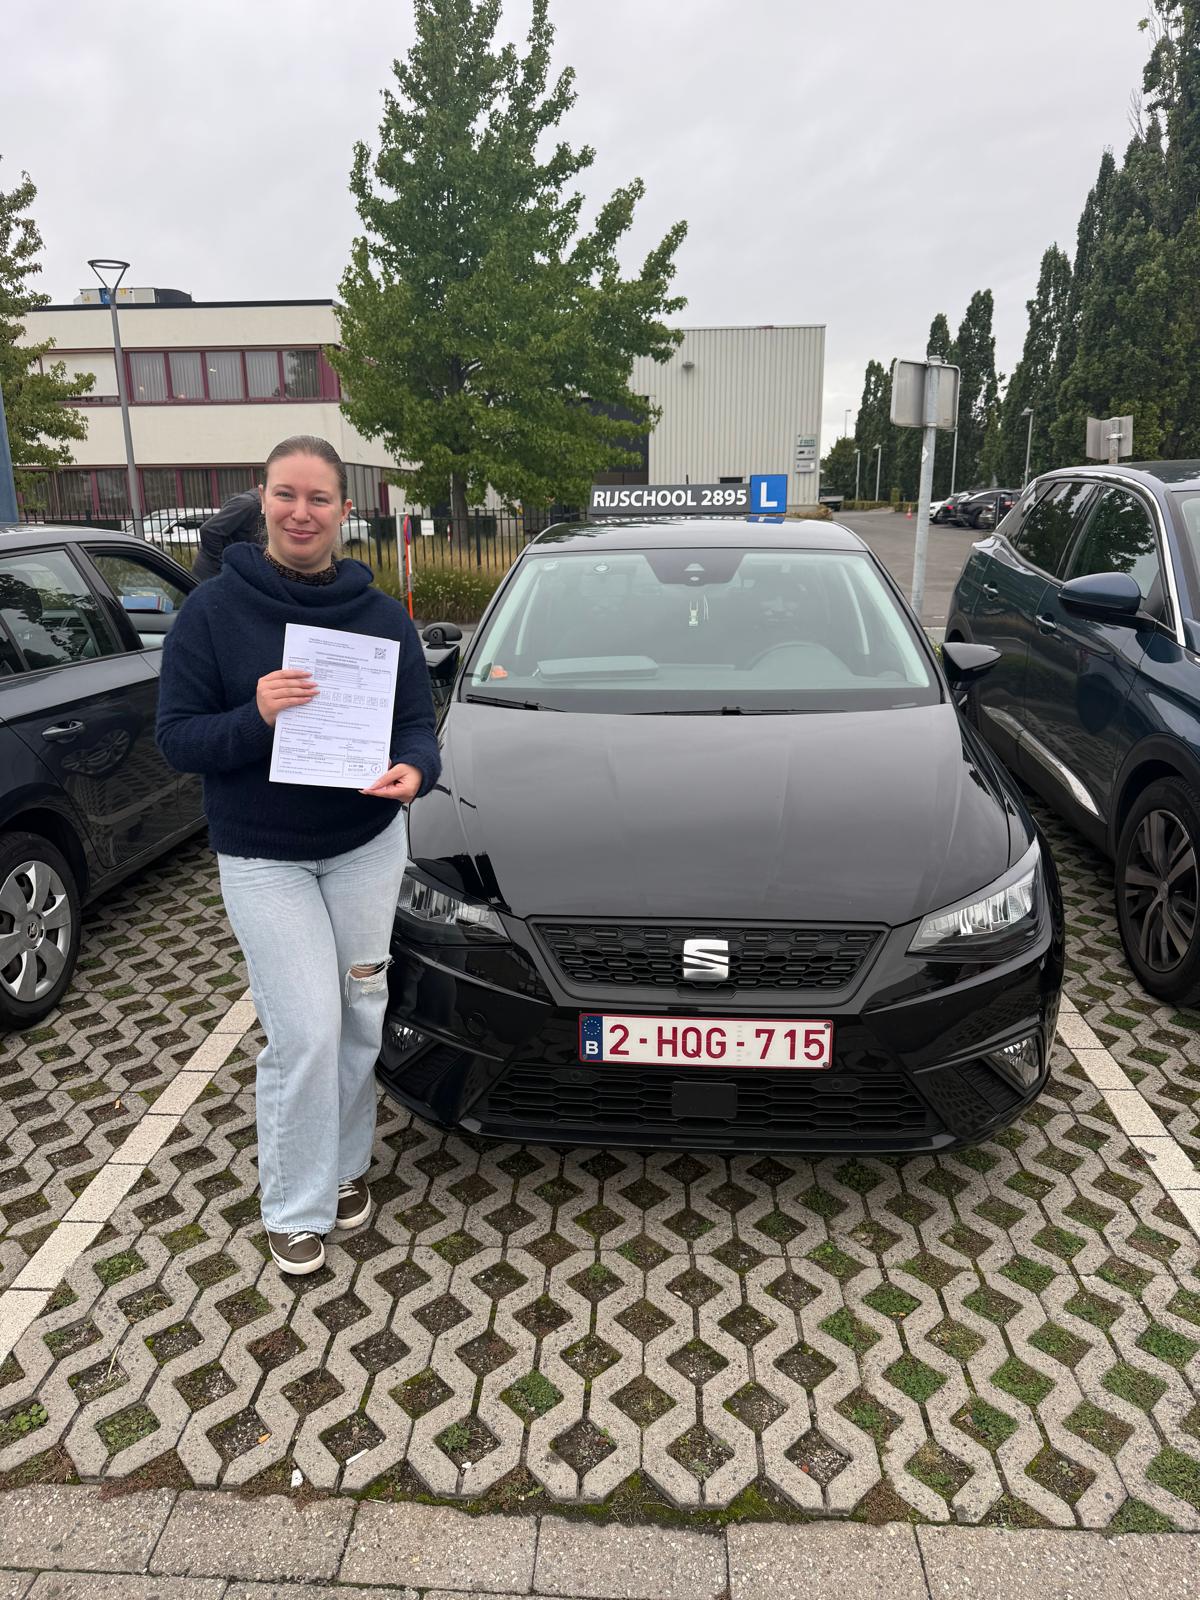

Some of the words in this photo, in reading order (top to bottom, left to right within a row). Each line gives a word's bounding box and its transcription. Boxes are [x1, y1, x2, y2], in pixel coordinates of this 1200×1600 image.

[593, 490, 697, 507] RIJSCHOOL
[701, 489, 747, 506] 2895
[760, 481, 778, 508] L
[585, 1040, 599, 1055] B
